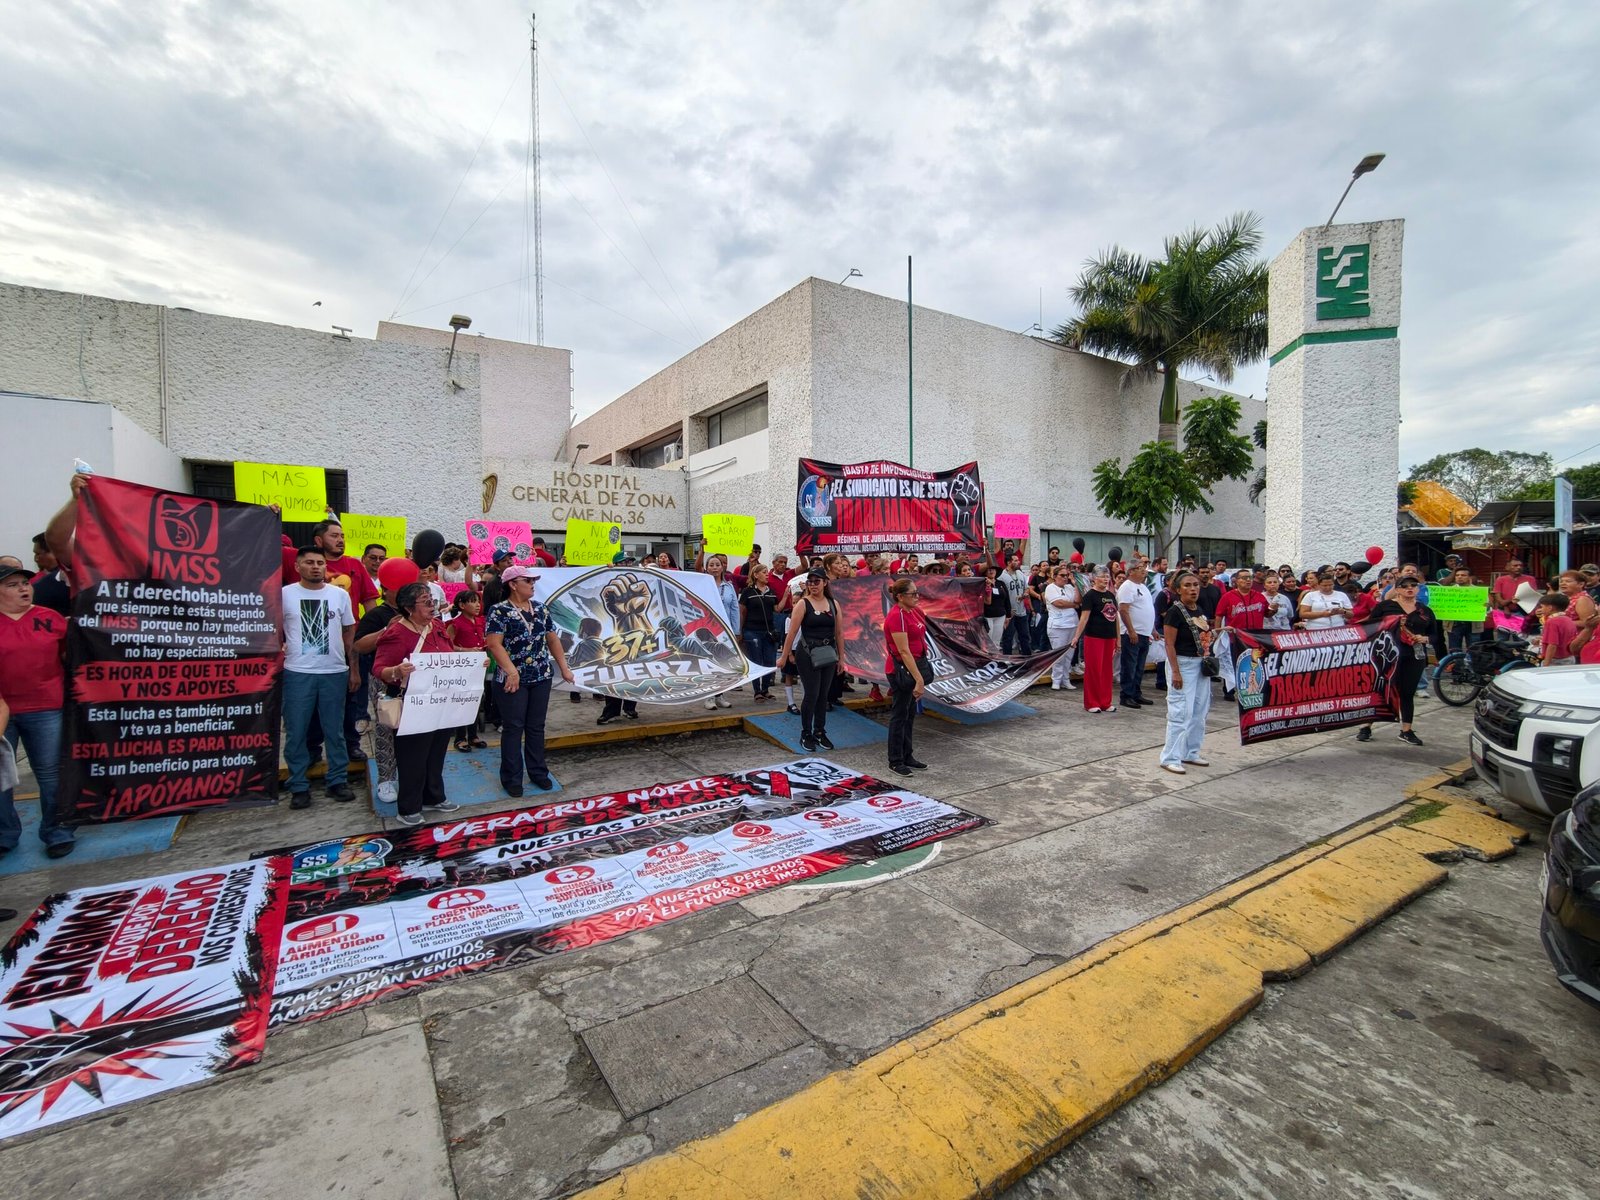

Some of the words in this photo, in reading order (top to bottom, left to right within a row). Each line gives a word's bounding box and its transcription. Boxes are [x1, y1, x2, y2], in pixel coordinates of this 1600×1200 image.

[262, 470, 309, 488] MAS
[553, 471, 641, 491] HOSPITAL
[845, 478, 898, 498] SINDICATO
[899, 479, 911, 496] ES
[913, 480, 925, 498] DE
[928, 482, 948, 499] SUS
[512, 485, 591, 505] GENERAL
[598, 490, 619, 506] DE
[625, 493, 676, 510] ZONA
[360, 519, 385, 529] UNA
[721, 516, 734, 525] UN
[591, 525, 608, 538] NO
[709, 525, 748, 538] SALARIO
[837, 533, 860, 544] RÉGIMEN
[862, 534, 870, 543] DE
[871, 534, 908, 543] JUBILACIONES
[916, 534, 944, 543] PENSIONES
[579, 538, 587, 548] A
[719, 537, 745, 548] DIGNO
[151, 550, 221, 585] IMSS
[97, 580, 110, 598] A
[115, 581, 129, 598] ti
[133, 583, 264, 606] derechohabiente
[94, 602, 118, 615] que
[121, 602, 170, 617] siempre
[172, 604, 184, 616] te
[187, 602, 216, 618] estás
[217, 608, 265, 621] quejando
[78, 615, 99, 628] del
[102, 616, 138, 630] IMSS
[140, 619, 183, 632] porque
[185, 621, 200, 631] no
[202, 620, 222, 634] hay
[223, 620, 277, 634] medicinas,
[111, 633, 155, 645] porque
[157, 634, 172, 644] no
[174, 633, 194, 646] hay
[197, 634, 250, 646] consultas,
[1301, 631, 1311, 645] DE
[1308, 627, 1361, 645] IMPOSICIONES!
[125, 648, 139, 658] no
[142, 646, 163, 660] hay
[166, 646, 238, 660] especialistas,
[603, 629, 670, 664] 37+1
[427, 654, 471, 668] Jubilados
[1264, 652, 1280, 680] ¡EL
[1280, 646, 1331, 675] SINDICATO
[1331, 644, 1345, 670] ES
[1342, 643, 1355, 667] DE
[1354, 641, 1372, 664] SUS
[86, 666, 104, 681] ES
[109, 665, 153, 680] HORA
[158, 665, 177, 679] DE
[181, 664, 210, 680] QUE
[215, 664, 230, 677] TE
[233, 663, 268, 677] UNAS
[571, 658, 733, 687] FUERZA
[120, 684, 132, 698] Y
[137, 682, 172, 697] NOS
[176, 679, 240, 696] APOYES.
[977, 673, 1015, 694] CARDEL
[1269, 664, 1375, 706] TRABAJADORES!
[430, 693, 448, 705] base
[1254, 708, 1283, 721] RÉGIMEN
[1284, 706, 1294, 716] DE
[1295, 700, 1335, 714] JUBILACIONES
[1336, 699, 1340, 708] Y
[1341, 695, 1372, 708] PENSIONES
[88, 708, 117, 721] Esta
[120, 707, 155, 721] lucha
[158, 709, 172, 719] es
[175, 704, 224, 719] también
[227, 705, 252, 718] para
[255, 702, 263, 715] ti
[131, 725, 143, 736] te
[174, 719, 235, 733] beneficiar.
[71, 743, 109, 759] ESTA
[113, 740, 163, 757] LUCHA
[189, 737, 225, 753] PARA
[229, 733, 273, 749] TODOS.
[129, 759, 189, 775] beneficio
[192, 759, 219, 772] para
[222, 754, 256, 768] todos,
[807, 772, 853, 784] IMSS
[101, 768, 245, 822] ¡APÓYANOS!
[432, 795, 617, 843] VERACRUZ
[434, 832, 498, 858] EN
[512, 818, 570, 840] PIE
[584, 807, 625, 825] DE
[639, 783, 760, 814] LUCHA
[498, 822, 624, 859] NUESTRAS
[631, 797, 744, 827] DEMANDAS
[896, 826, 913, 836] IMSS
[914, 819, 938, 830] FUERTE
[892, 825, 937, 842] TRABAJADORES
[301, 854, 328, 868] SS
[294, 860, 381, 883] SNTSS
[552, 878, 597, 893] INSUMOS
[556, 881, 614, 903] SUFICIENTES
[614, 903, 650, 921] POR
[654, 879, 730, 906] NUESTROS
[734, 858, 805, 884] DERECHOS
[645, 912, 655, 921] Y
[661, 905, 681, 917] EL
[685, 886, 741, 909] FUTURO
[744, 877, 772, 889] DEL
[774, 866, 808, 881] IMSS
[206, 864, 256, 938] CORRESPONDE
[538, 905, 558, 914] Para
[127, 902, 161, 924] POR
[424, 915, 468, 929] PLAZAS
[468, 904, 521, 919] VACANTES
[551, 911, 564, 919] los
[115, 920, 152, 946] QUE
[126, 873, 228, 984] DERECHO
[409, 923, 471, 940] Contratación
[411, 931, 459, 945] suficiente
[460, 925, 483, 935] para
[484, 916, 525, 929] disminuir
[432, 930, 486, 947] sobrecarga
[286, 933, 360, 956] AUMENTO
[333, 944, 380, 959] inflación
[340, 934, 385, 949] DIGNO
[196, 936, 236, 968] NOS
[289, 971, 318, 982] base
[321, 954, 388, 974] trabajadora.
[311, 954, 361, 971] esfuerzo
[269, 960, 416, 1013] TRABAJADORES
[423, 940, 485, 963] UNIDOS
[341, 971, 405, 1001] SERÁN
[411, 949, 496, 980] VENCIDOS
